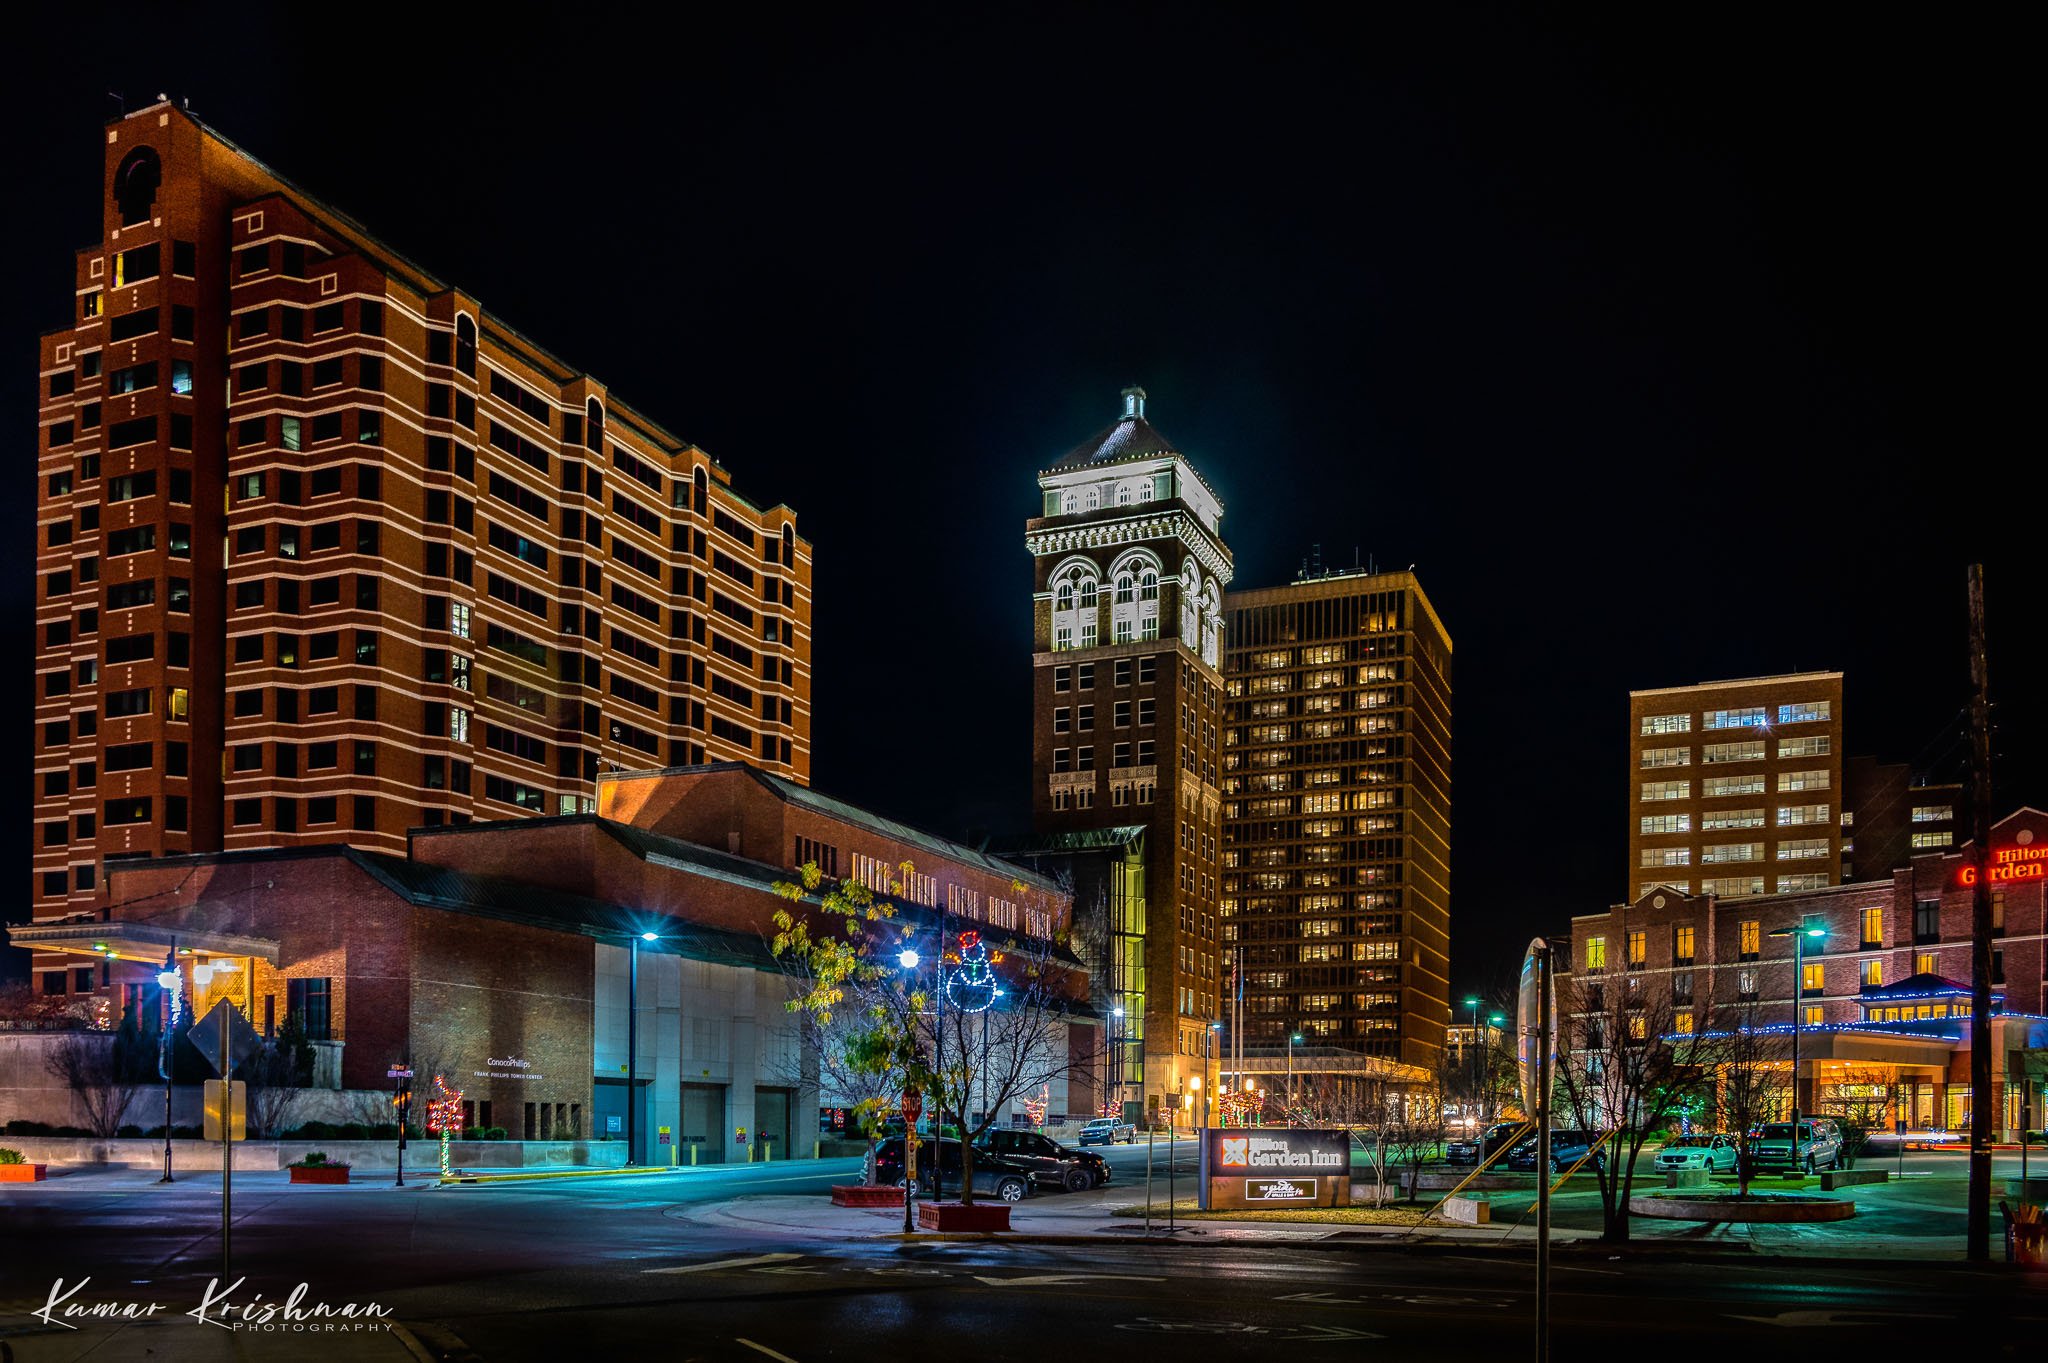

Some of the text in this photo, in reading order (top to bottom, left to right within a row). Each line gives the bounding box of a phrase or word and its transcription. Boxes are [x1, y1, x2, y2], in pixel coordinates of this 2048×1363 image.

[1961, 863, 2044, 884] Grden
[487, 1057, 531, 1069] ConocoPhillips
[903, 1097, 921, 1111] STOP
[1248, 1150, 1342, 1167] Garden Inn
